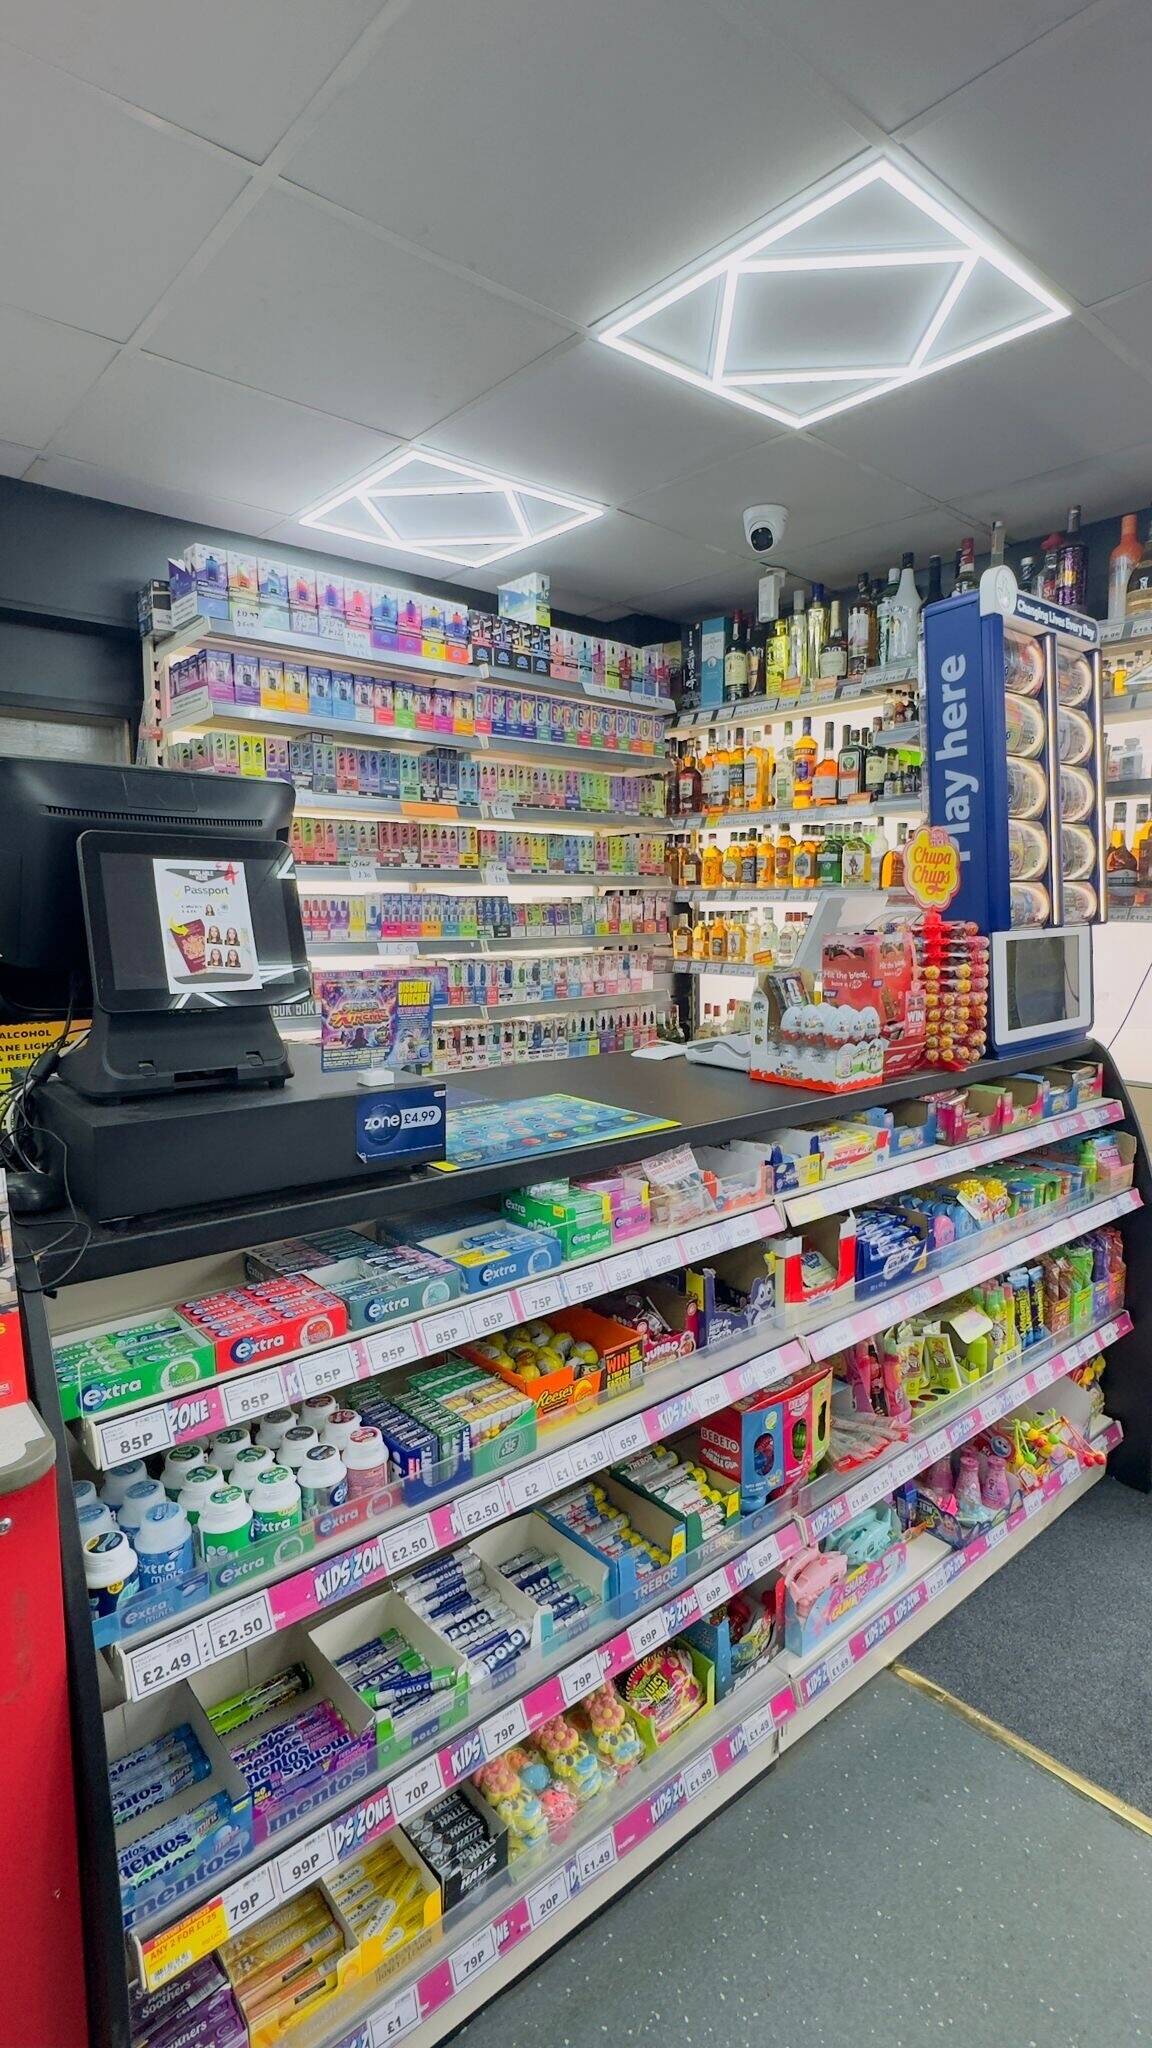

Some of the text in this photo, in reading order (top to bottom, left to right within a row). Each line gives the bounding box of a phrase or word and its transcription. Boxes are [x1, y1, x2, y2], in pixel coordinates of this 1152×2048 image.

[1017, 599, 1049, 624] Changing
[1048, 611, 1065, 628] Lives
[1065, 618, 1084, 636] Every
[1082, 624, 1096, 640] Day
[935, 654, 980, 862] lay here
[913, 846, 951, 866] Chupa
[911, 863, 951, 886] Chups
[184, 885, 230, 897] Passport
[907, 1010, 925, 1022] WIN
[0, 1029, 52, 1040] ALCOHOL
[363, 1109, 436, 1131] zone £4.99
[483, 1262, 518, 1282] extra
[576, 1281, 595, 1295] 75P
[369, 1297, 411, 1318] extra
[531, 1296, 552, 1310] 75P
[482, 1312, 504, 1327] 85P
[235, 1335, 285, 1358] extra
[435, 1328, 459, 1344] 85P
[381, 1346, 406, 1363] 85P
[607, 1350, 630, 1374] WIN
[314, 1368, 341, 1386] 85P
[83, 1379, 142, 1406] extra
[240, 1392, 270, 1412] 85P
[168, 1399, 211, 1434] ZONE
[119, 1432, 154, 1455] 85P
[619, 1434, 638, 1450] 65P
[701, 1427, 739, 1453] BEBETO
[576, 1451, 605, 1472] £1.30
[525, 1482, 540, 1497] £2
[320, 1509, 359, 1534] extra
[466, 1502, 500, 1525] £2.50
[391, 1537, 428, 1563] £2.50
[758, 1552, 773, 1567] 69P
[219, 1556, 265, 1584] extra
[313, 1544, 382, 1602] KIDS ZON
[524, 1578, 550, 1595] OLO
[633, 1566, 679, 1599] TREBOR
[706, 1586, 722, 1602] 69P
[124, 1599, 168, 1626] extra
[218, 1616, 264, 1649] £2.50
[448, 1612, 490, 1638] POLO
[487, 1630, 525, 1668] POLO
[640, 1628, 658, 1647] 69P
[142, 1652, 192, 1687] £2.49
[572, 1672, 592, 1692] 79P
[413, 1724, 439, 1745] POLO
[493, 1723, 516, 1744] 79P
[749, 1719, 770, 1742] £1.49
[450, 1731, 483, 1778] KIDS
[404, 1780, 429, 1803] 70P
[689, 1768, 713, 1793] £1.99
[112, 1780, 163, 1816] entos
[267, 1761, 368, 1837] mentos
[430, 1790, 461, 1816] HALLS
[650, 1790, 672, 1825] KIDS
[357, 1795, 391, 1832] ZONE
[438, 1803, 470, 1828] HALLS
[292, 1852, 320, 1880] 99P
[459, 1851, 498, 1891] HALLS
[583, 1849, 611, 1876] £1.49
[122, 1843, 242, 1928] mentos
[229, 1891, 260, 1921] 79P
[539, 1892, 559, 1916] 20P
[149, 1944, 168, 1961] ANY
[177, 1926, 196, 1943] FOR
[463, 1949, 486, 1974] 79P
[141, 1980, 192, 2020] Soothers
[386, 2015, 402, 2036] £1
